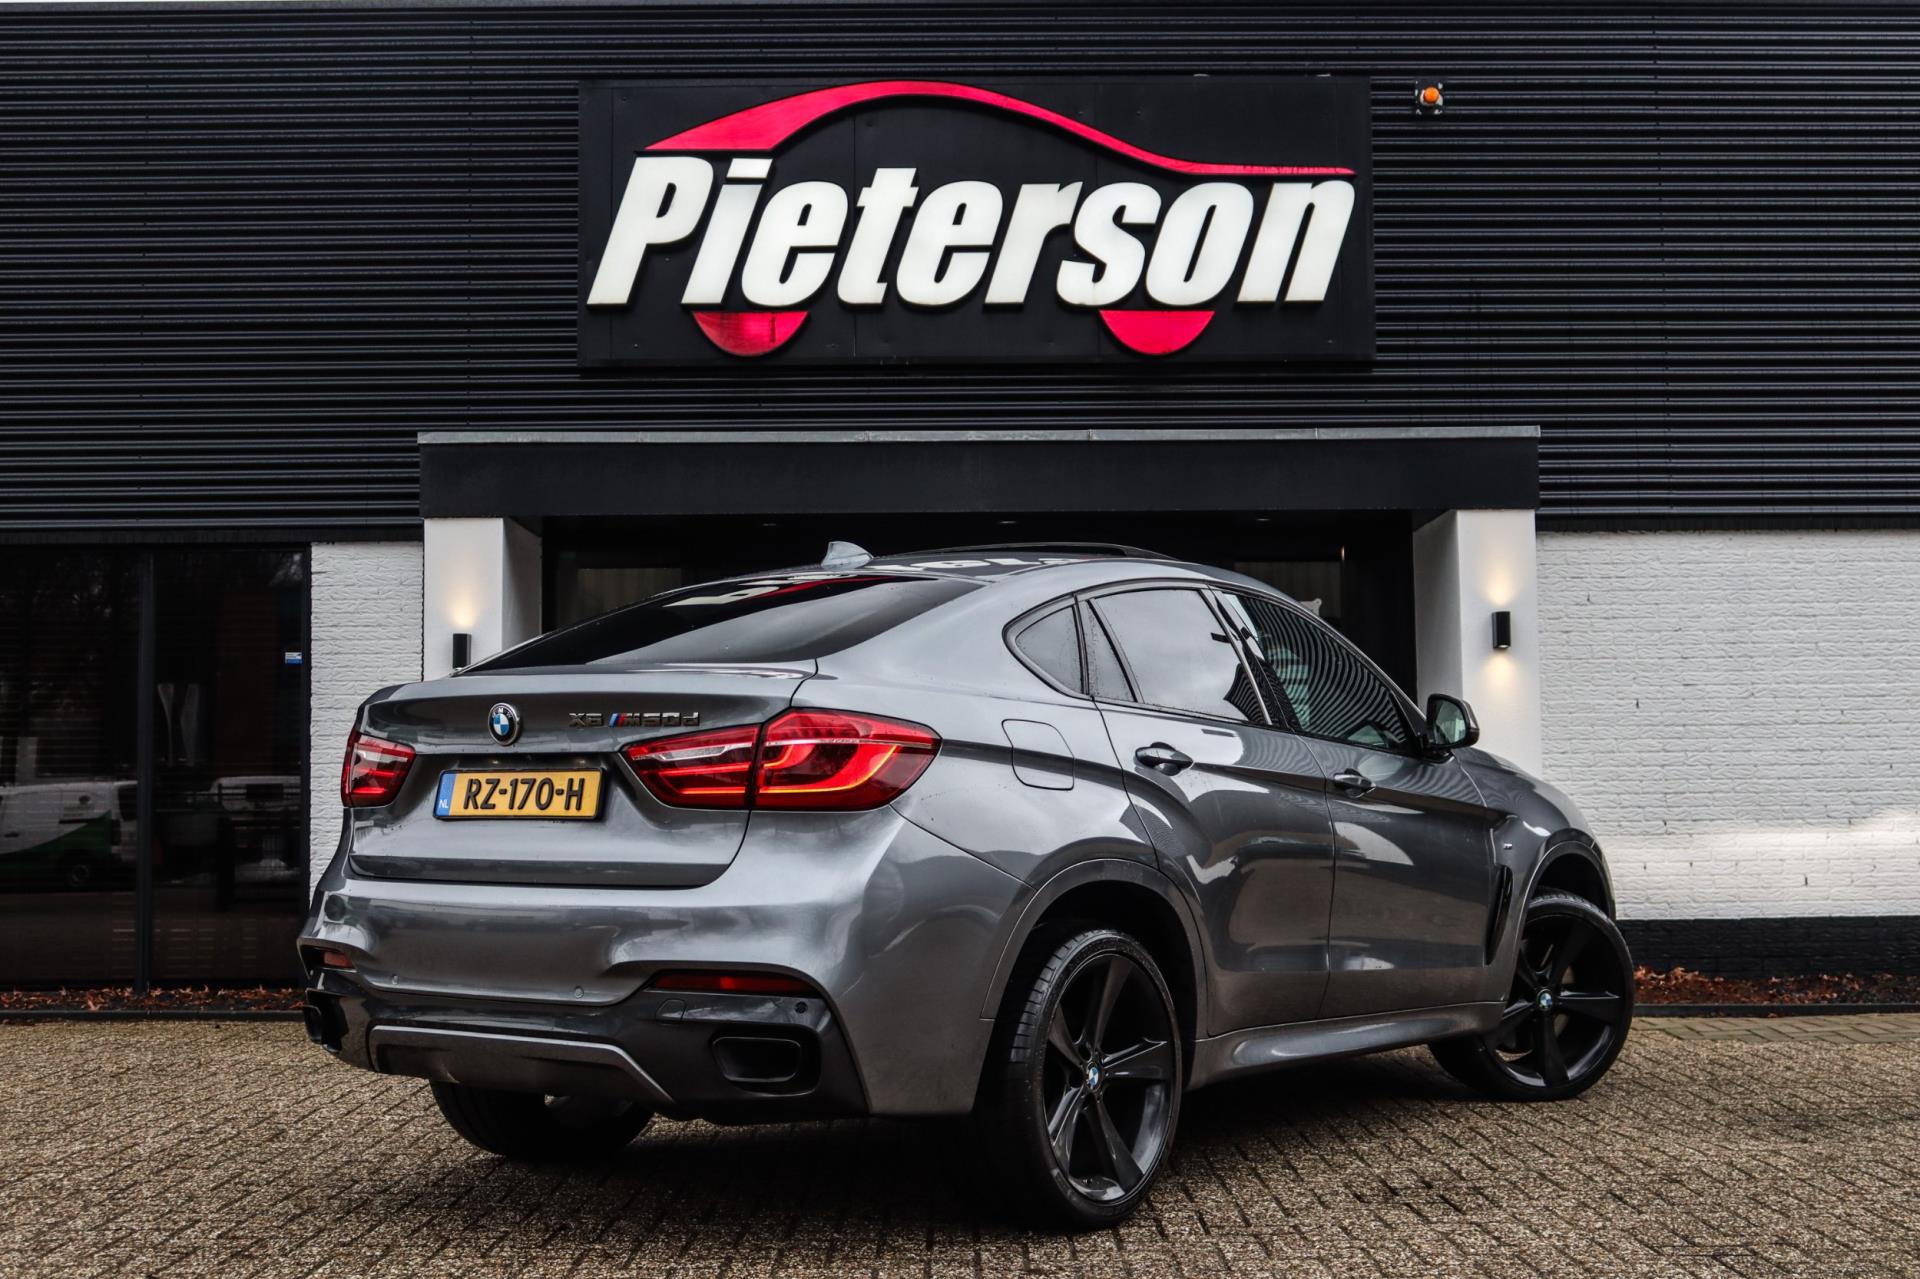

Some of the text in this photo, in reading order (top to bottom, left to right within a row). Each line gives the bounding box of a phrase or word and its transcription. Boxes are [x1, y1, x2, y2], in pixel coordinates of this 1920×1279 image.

[587, 156, 1357, 307] Pieterson
[569, 712, 602, 727] X6
[438, 798, 449, 809] NL
[463, 777, 585, 811] RZ-170-H
